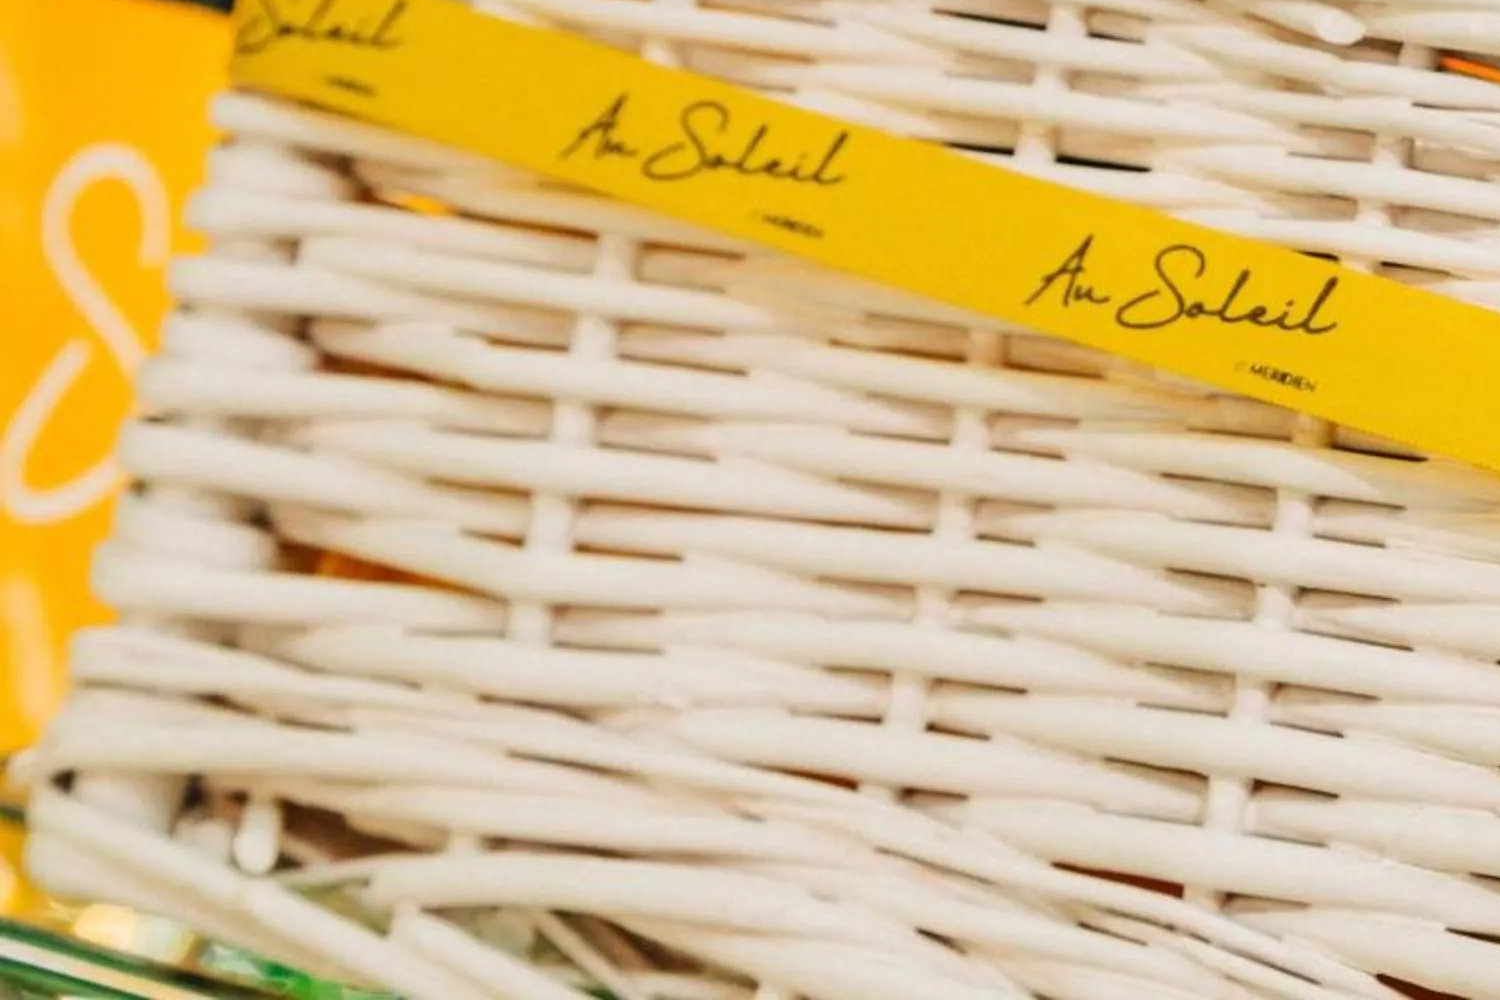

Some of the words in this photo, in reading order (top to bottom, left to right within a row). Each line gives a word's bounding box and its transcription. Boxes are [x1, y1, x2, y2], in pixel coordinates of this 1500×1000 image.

[560, 92, 638, 160] Au
[641, 101, 848, 186] Soleil
[1025, 233, 1110, 307] Au
[1115, 244, 1339, 335] Soleil
